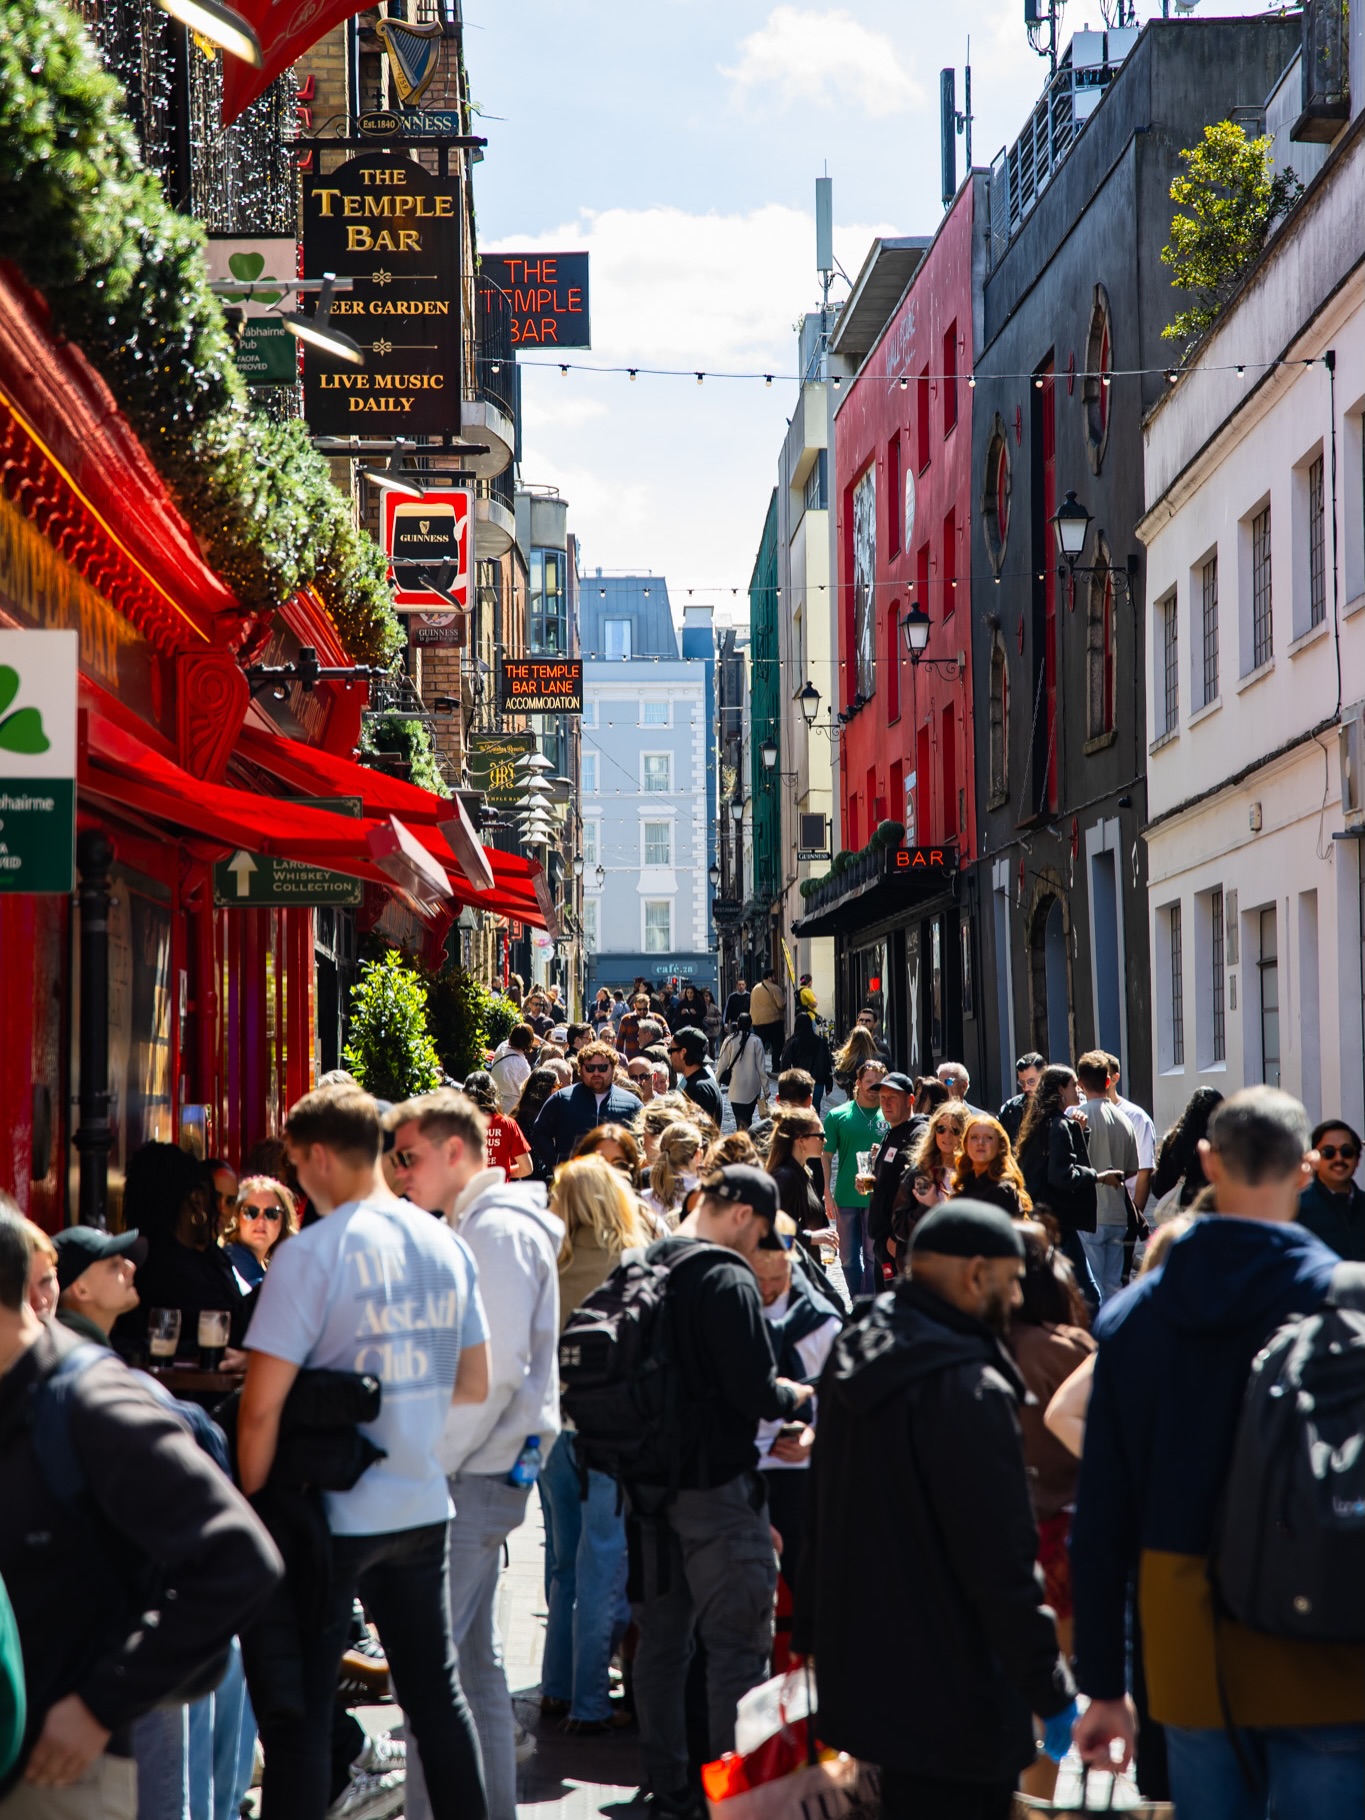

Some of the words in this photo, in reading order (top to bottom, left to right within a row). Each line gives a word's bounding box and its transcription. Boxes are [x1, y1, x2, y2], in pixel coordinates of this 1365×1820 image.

[400, 116, 452, 131] NNESS
[359, 169, 406, 185] THE
[311, 189, 455, 217] TEMPLE
[346, 225, 422, 251] BAR
[503, 259, 558, 283] THE
[314, 300, 366, 315] EER
[369, 300, 450, 315] GARDEN
[240, 339, 257, 349] Pub
[319, 374, 370, 389] LIVE
[373, 374, 444, 389] MUSIC
[348, 397, 416, 412] DAILY
[399, 533, 450, 543] GUINNESS
[418, 628, 459, 637] GUINNESS
[505, 665, 529, 678] THE
[531, 665, 579, 678] TEMPLE
[512, 681, 537, 694] BAR
[541, 681, 573, 694] LANE
[505, 696, 580, 710] ACCOMMODATION
[798, 852, 829, 860] GUINNESS
[896, 850, 944, 867] BAR
[273, 871, 331, 880] WHISKEY
[273, 882, 352, 892] COLLECTION
